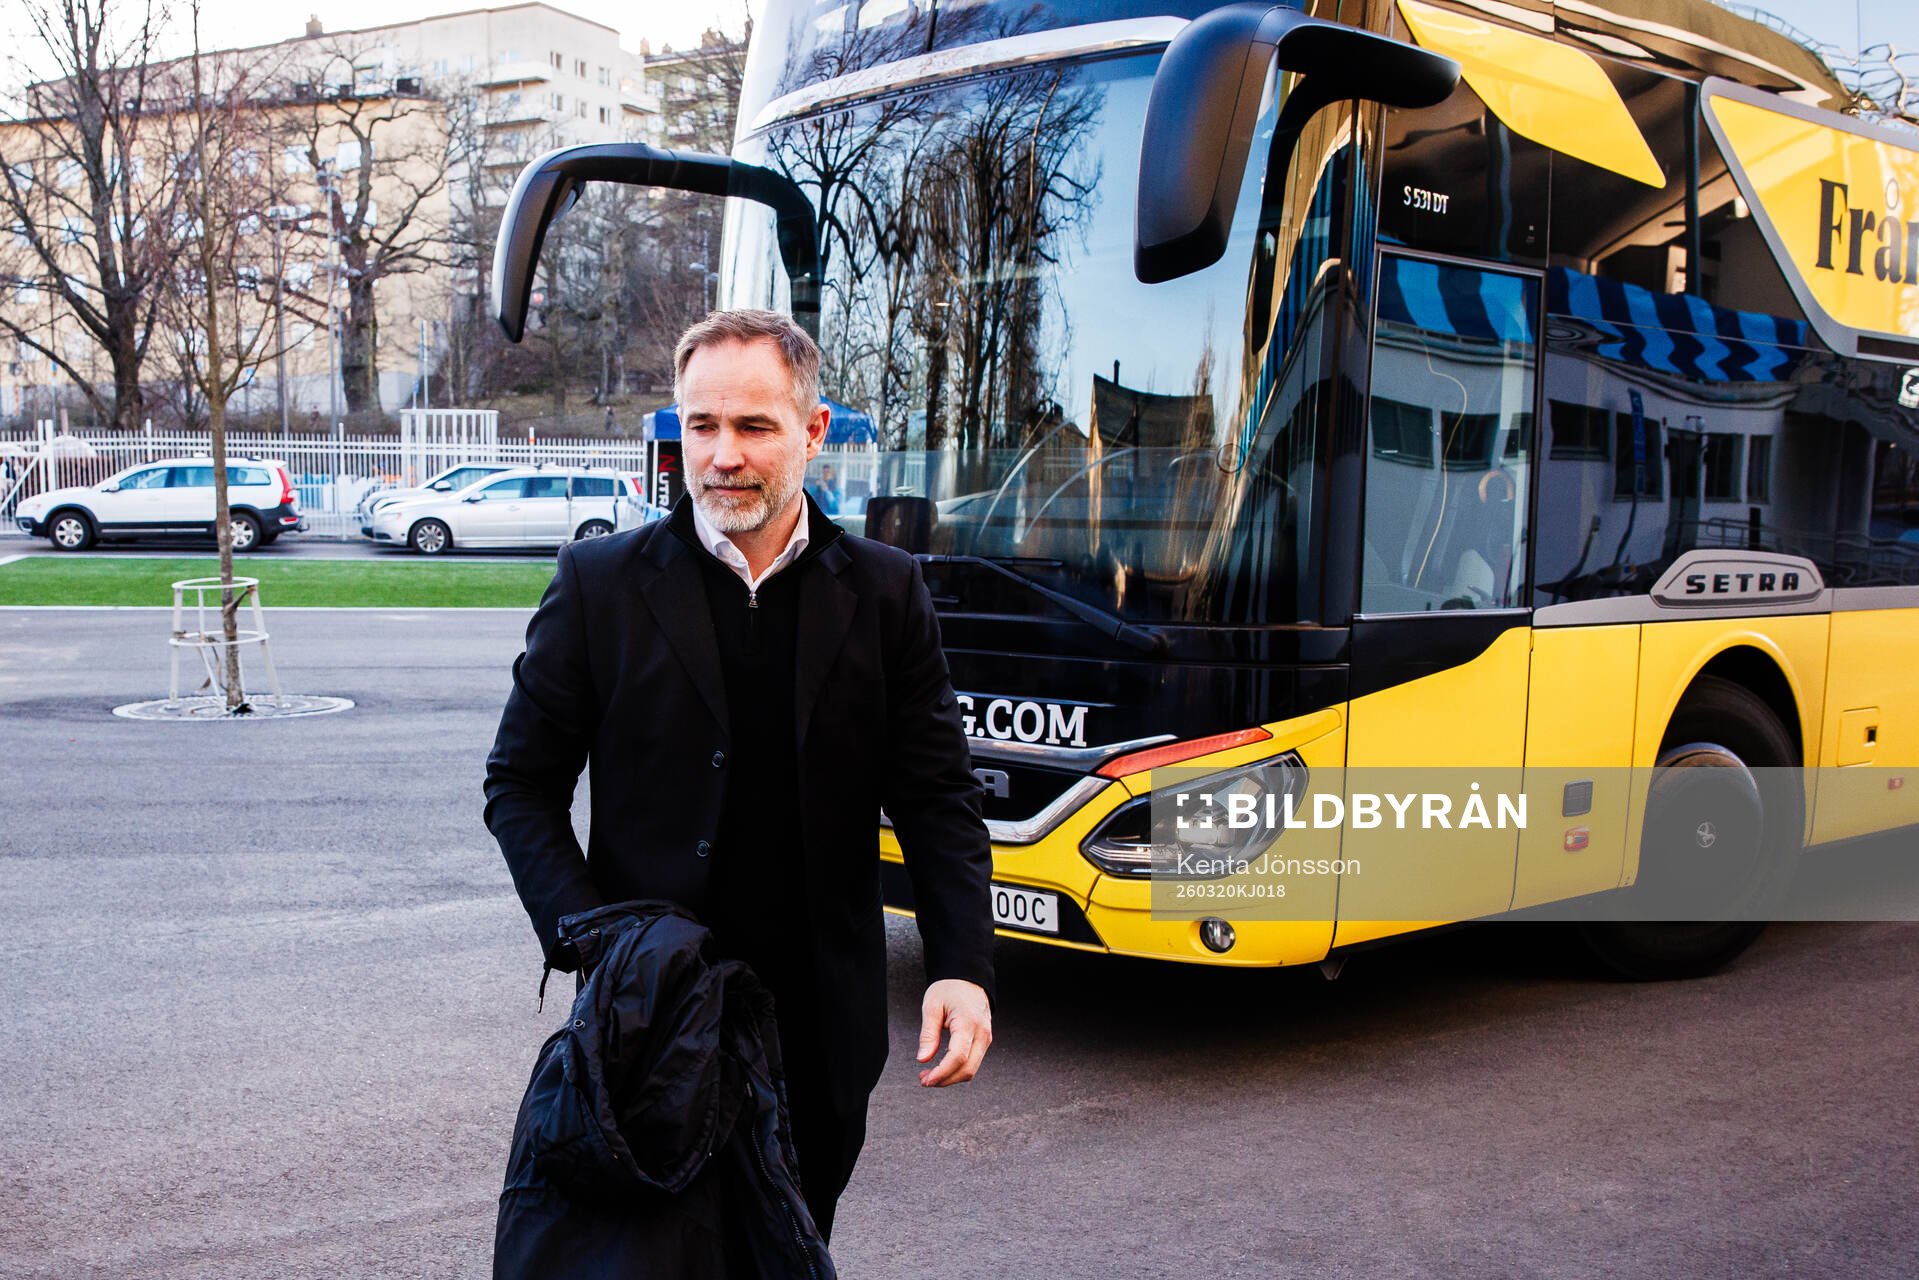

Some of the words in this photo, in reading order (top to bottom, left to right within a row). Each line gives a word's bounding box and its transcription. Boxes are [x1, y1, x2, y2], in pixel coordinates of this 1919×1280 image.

[1404, 186, 1411, 206] S
[1413, 188, 1431, 211] 531
[1433, 192, 1450, 214] DT
[1686, 573, 1799, 594] SETRA
